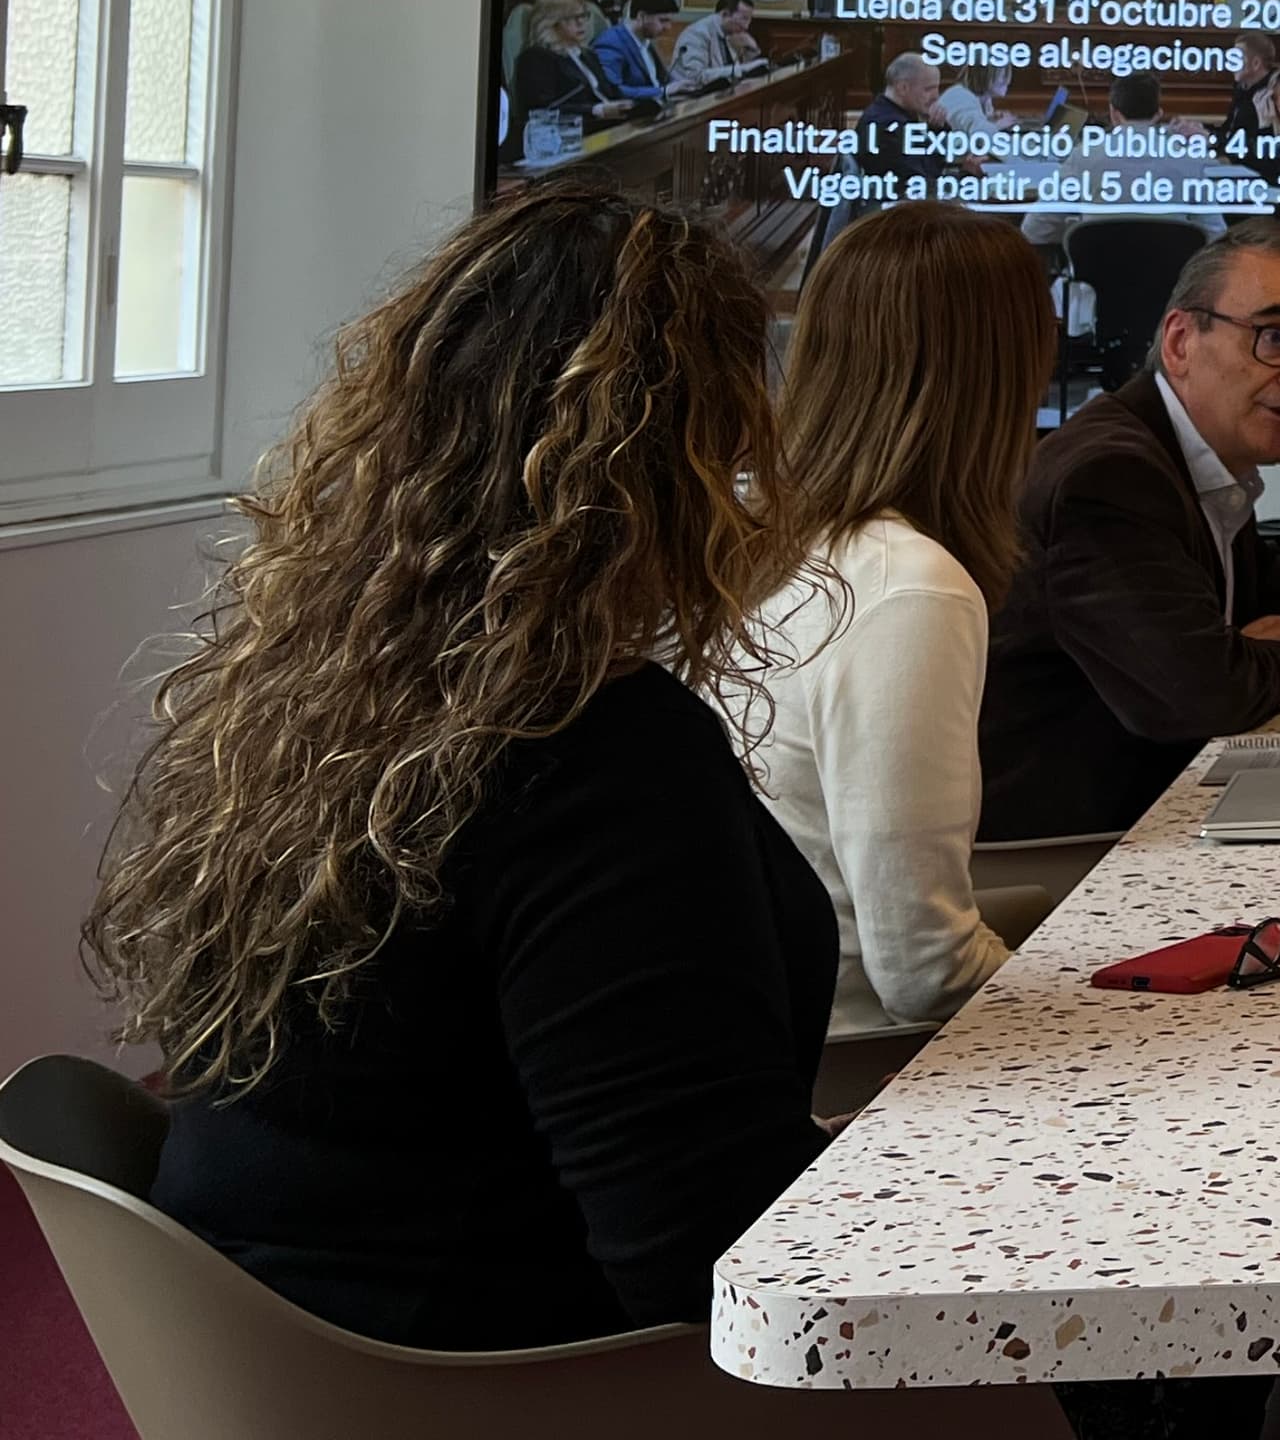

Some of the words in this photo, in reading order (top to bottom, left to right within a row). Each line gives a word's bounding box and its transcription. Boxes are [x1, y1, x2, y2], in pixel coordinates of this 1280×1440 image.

[921, 33, 1031, 67] Sense
[1039, 36, 1244, 77] al·legacions
[708, 120, 859, 155] Finalitza
[1082, 124, 1217, 160] Pública:
[1225, 129, 1248, 160] 4
[784, 166, 898, 208] Vigent
[906, 176, 926, 201] a
[937, 169, 1031, 202] partir
[1038, 170, 1092, 202] del
[1101, 171, 1122, 203] 5
[1130, 171, 1172, 203] de
[1183, 176, 1268, 208] març
